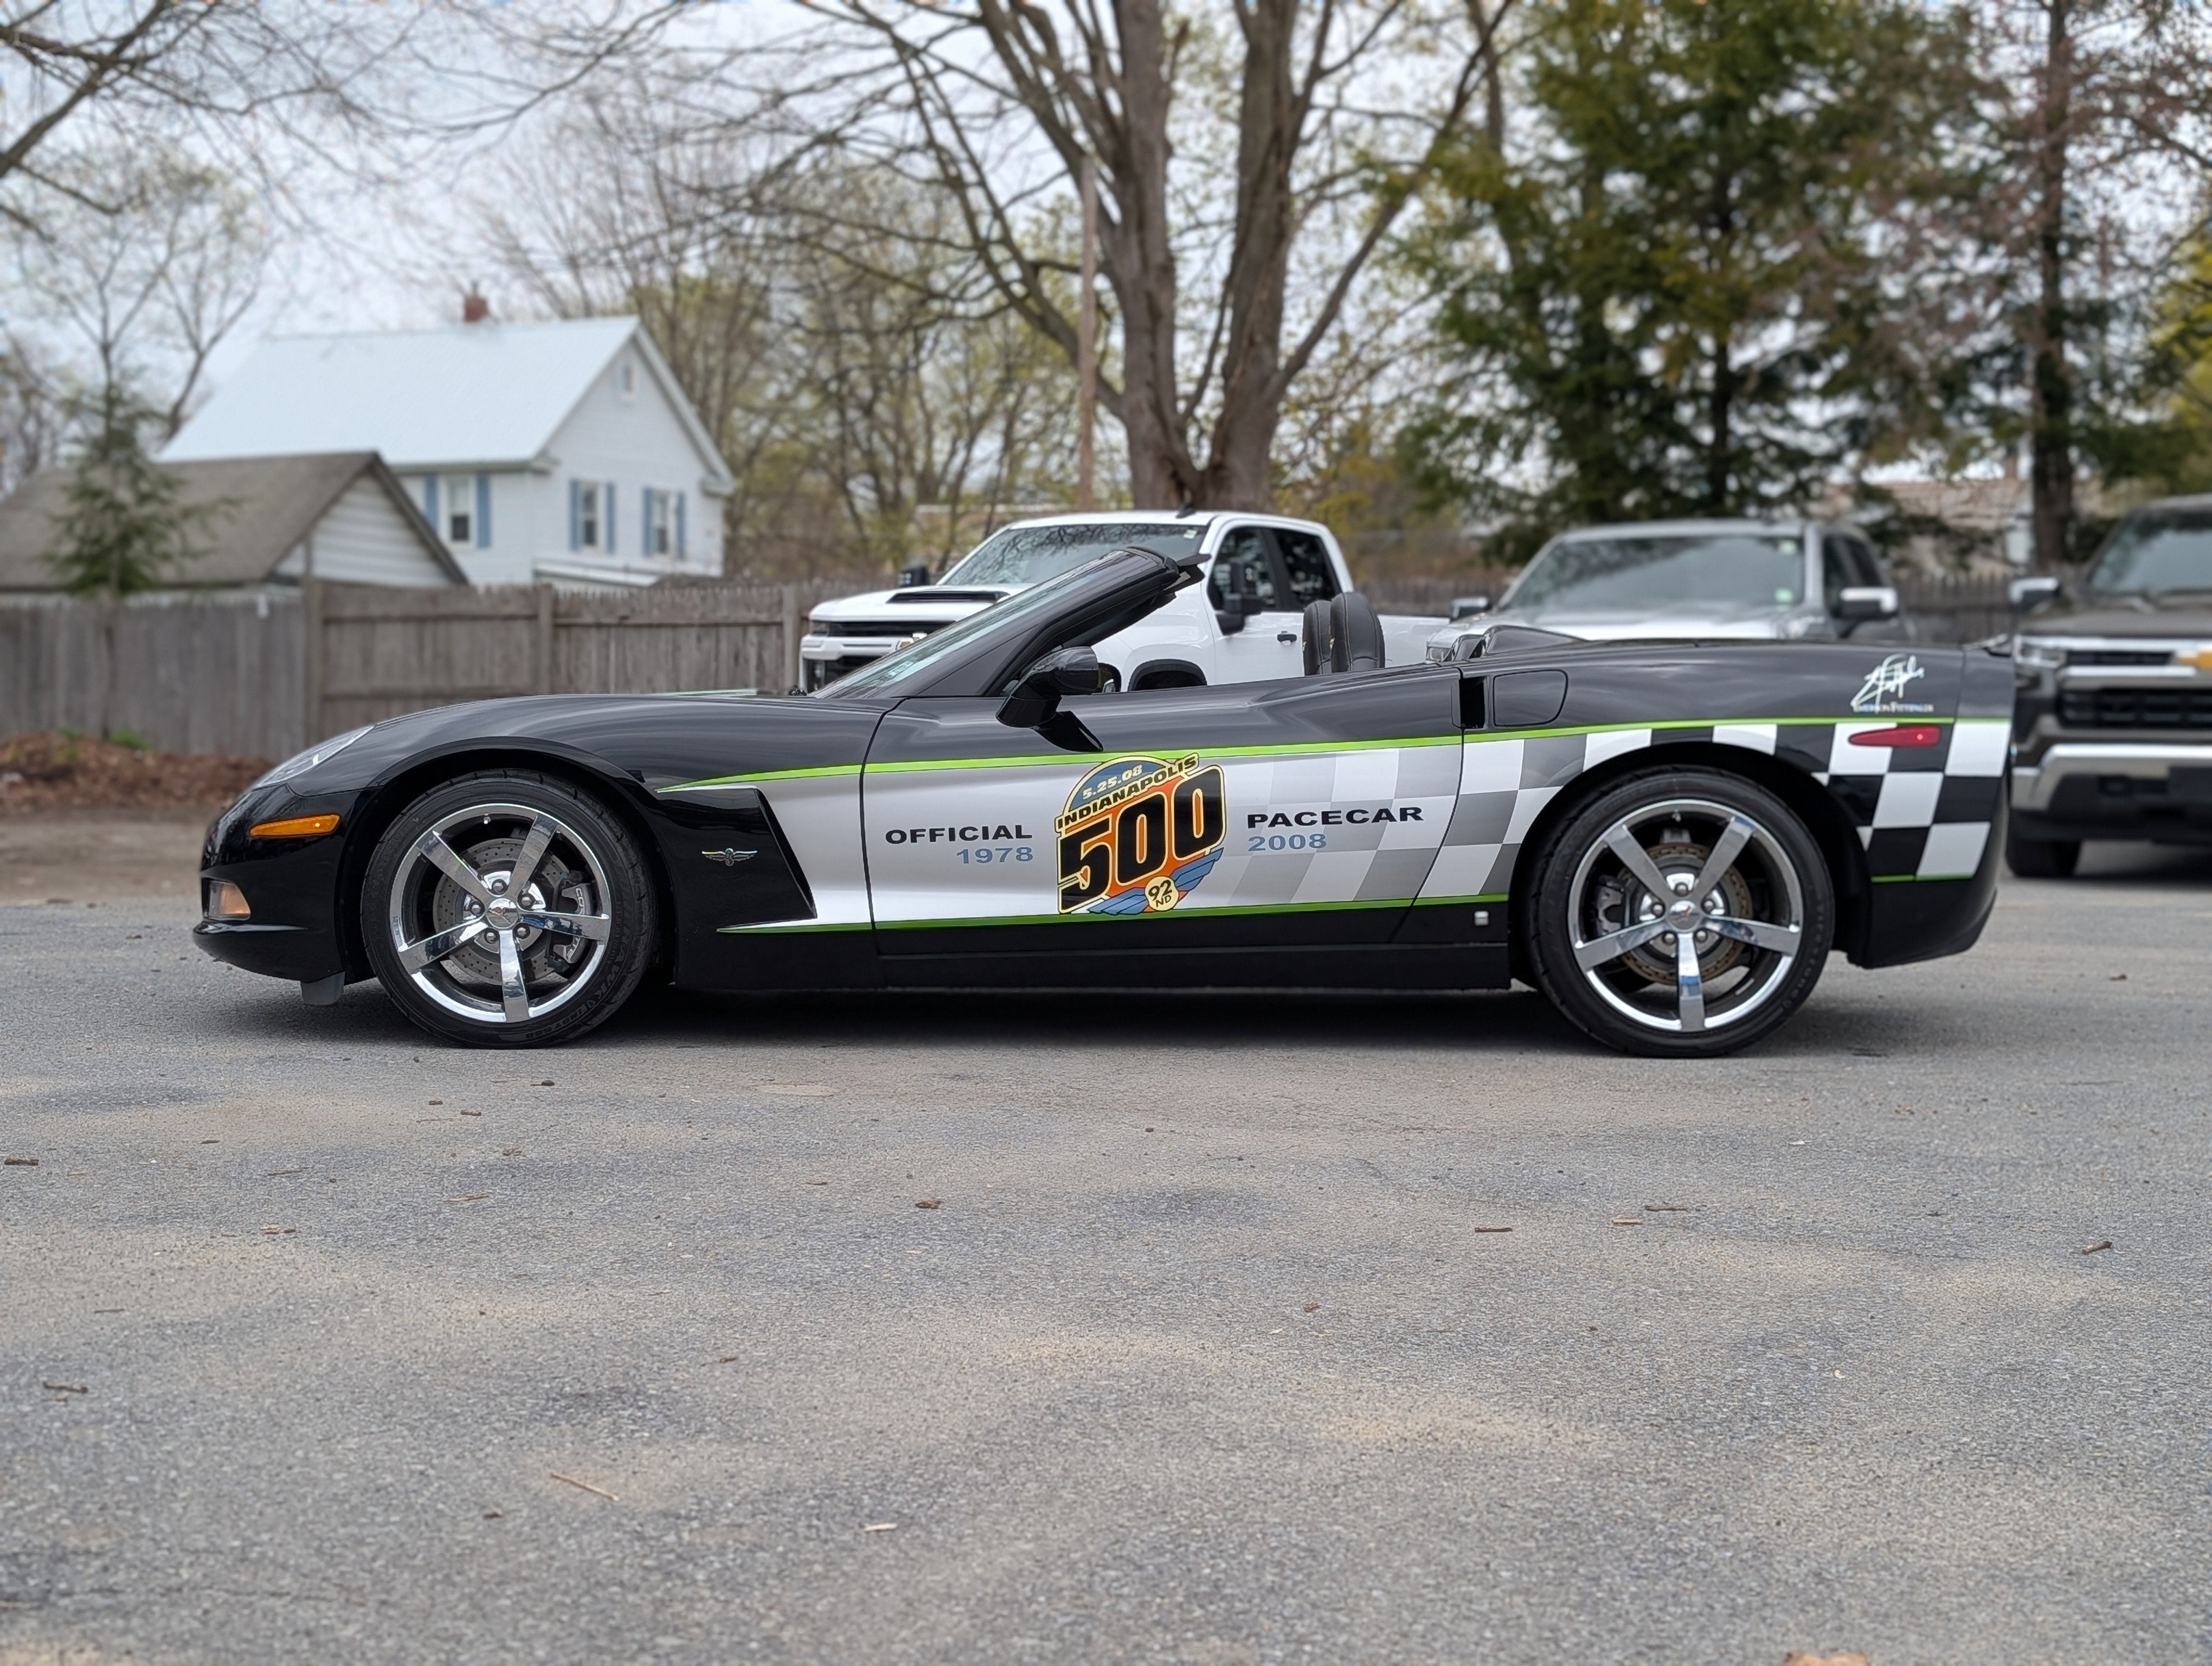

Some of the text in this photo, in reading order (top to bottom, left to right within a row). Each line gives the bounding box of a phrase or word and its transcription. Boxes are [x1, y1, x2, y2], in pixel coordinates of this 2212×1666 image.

[1057, 754, 1197, 830] INDIANAPOLIS
[1082, 764, 1142, 800] 5.25.08
[885, 806, 1424, 844] OFFICIAL PACECAR
[1059, 768, 1224, 912] 500
[956, 833, 1327, 864] 1978 2008
[1148, 879, 1173, 900] 92
[1155, 895, 1172, 908] ND
